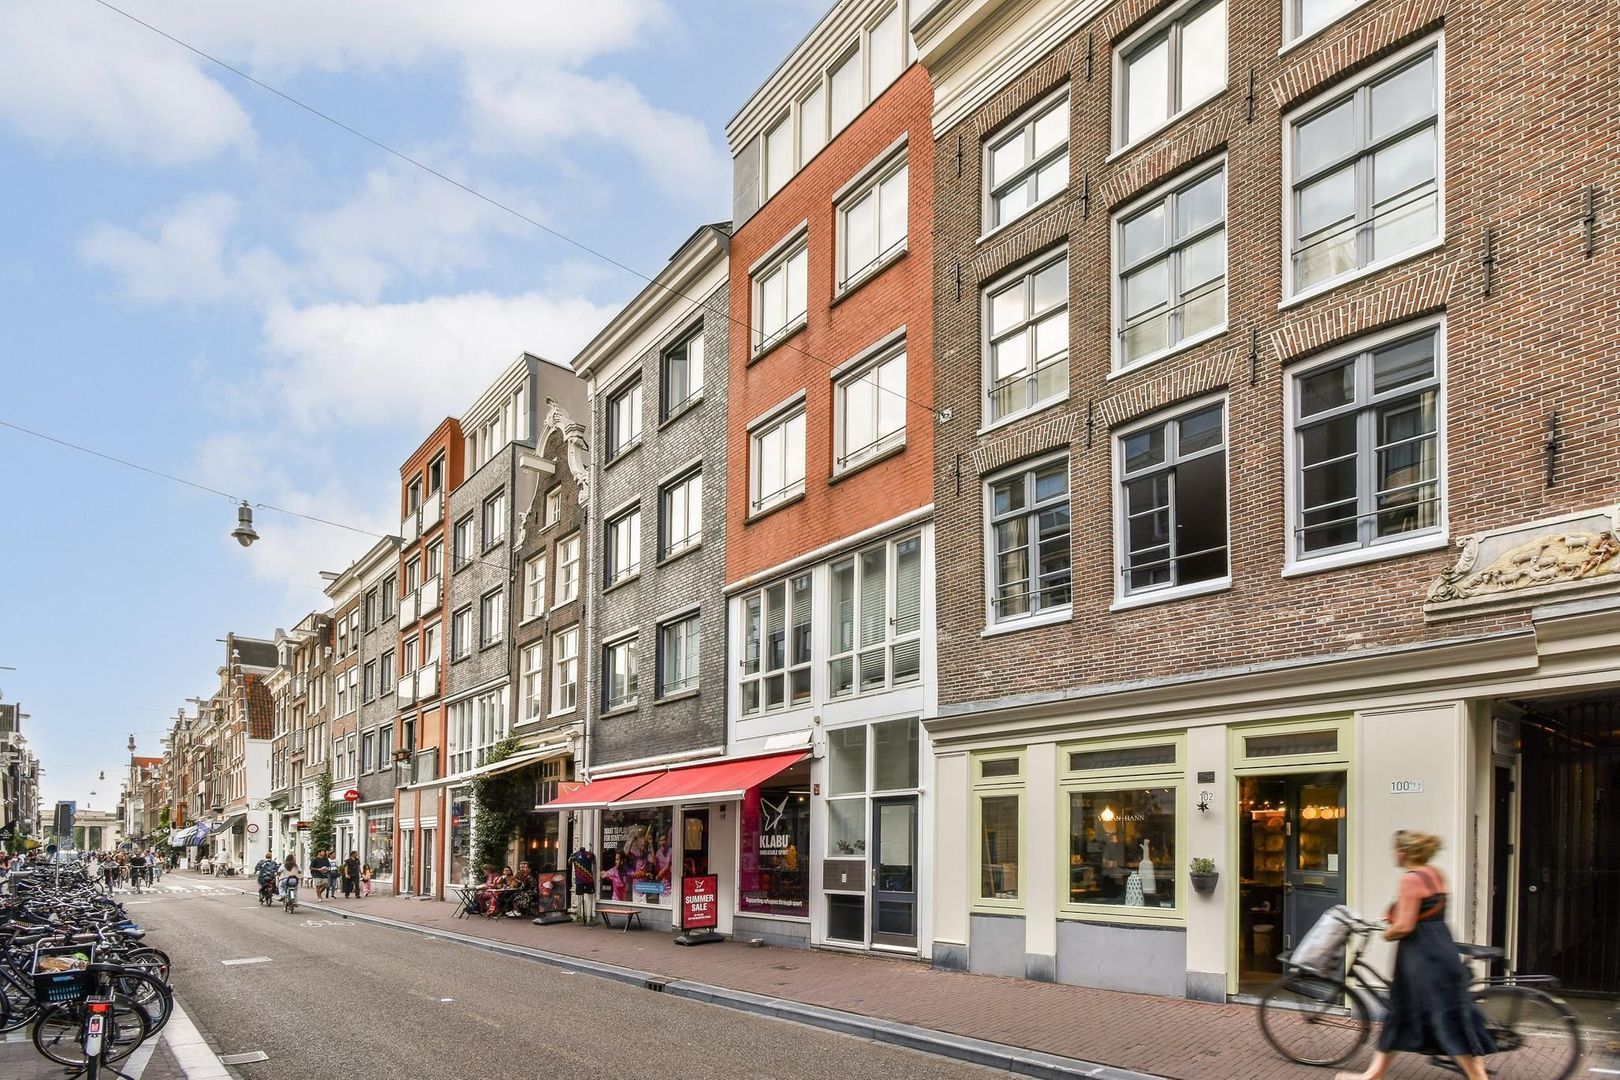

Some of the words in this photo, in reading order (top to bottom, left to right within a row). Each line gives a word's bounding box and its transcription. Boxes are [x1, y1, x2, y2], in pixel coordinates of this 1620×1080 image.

[760, 835, 788, 848] KLABU
[685, 894, 713, 903] SUMMER
[691, 903, 707, 911] SALE
